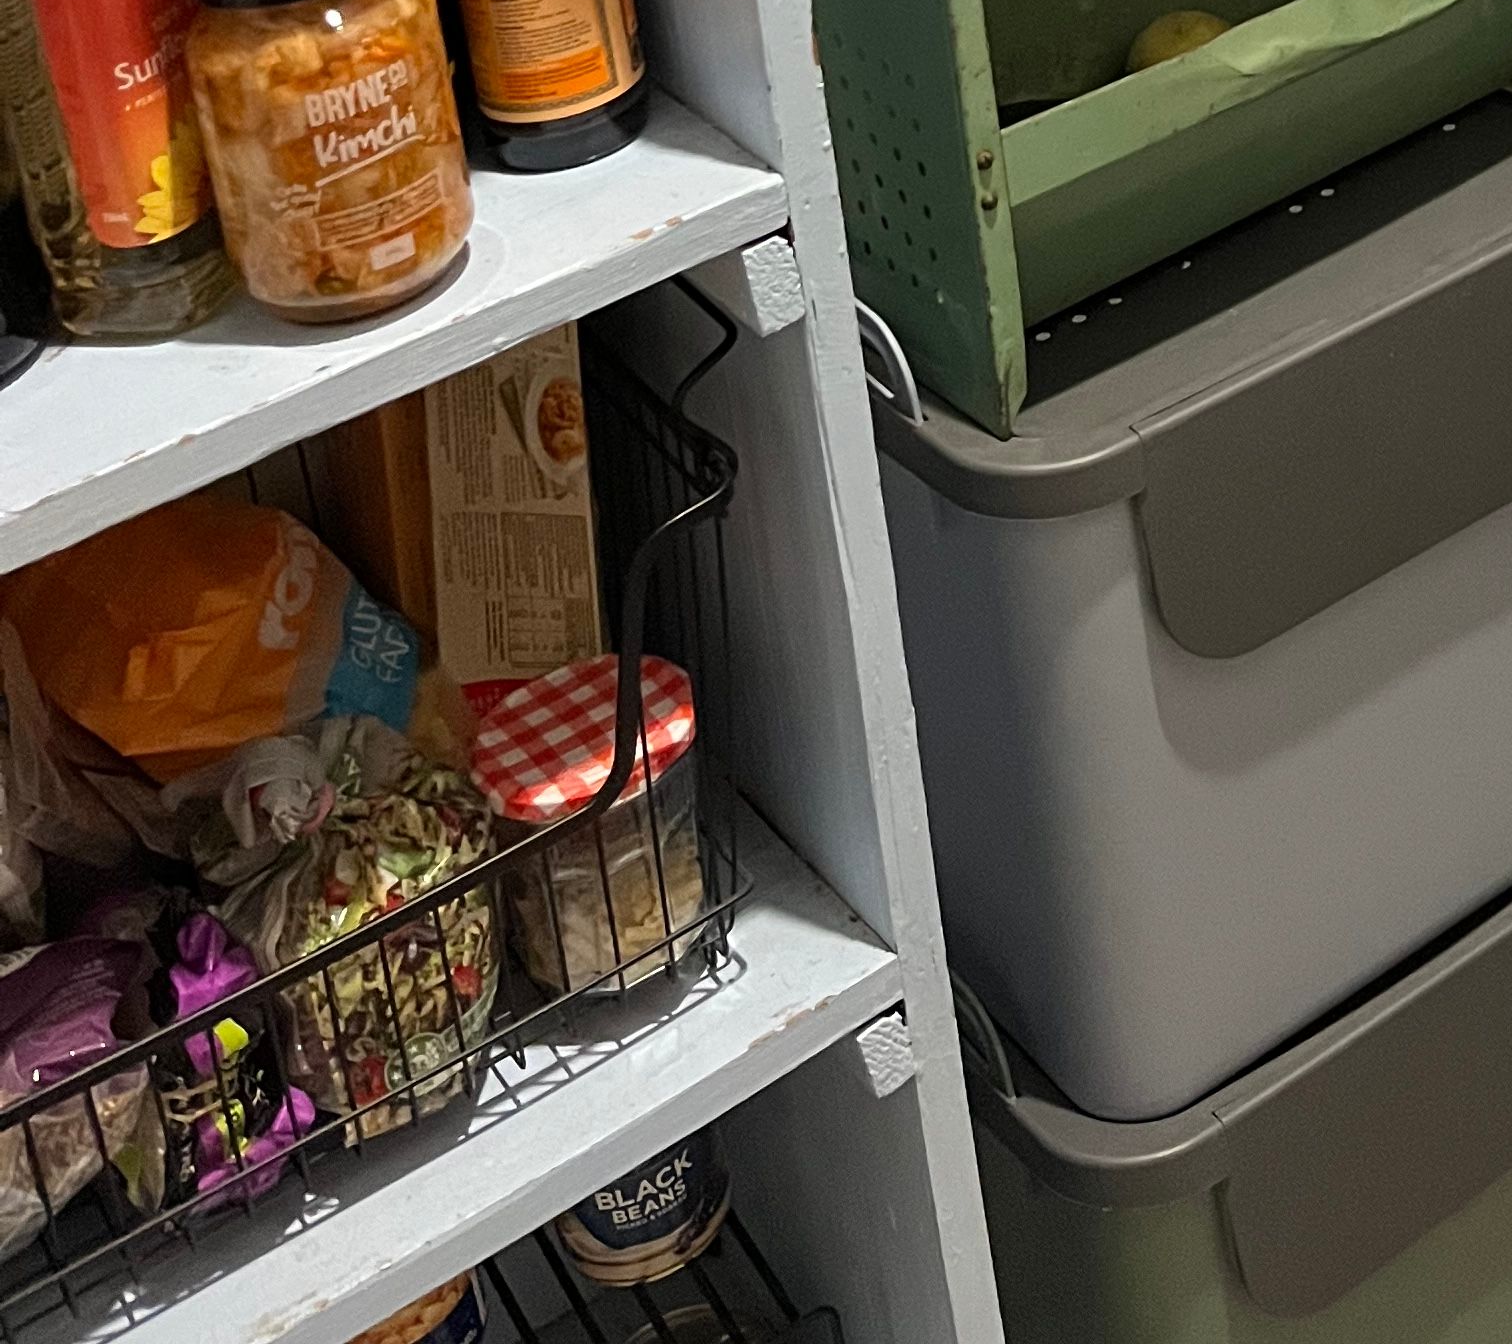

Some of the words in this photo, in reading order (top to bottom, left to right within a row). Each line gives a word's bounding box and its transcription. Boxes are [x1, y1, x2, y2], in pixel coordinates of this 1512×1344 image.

[305, 68, 392, 129] BRYNE
[313, 104, 417, 168] Kimchi
[594, 1147, 693, 1211] BLACK
[612, 1178, 687, 1225] BEANS
